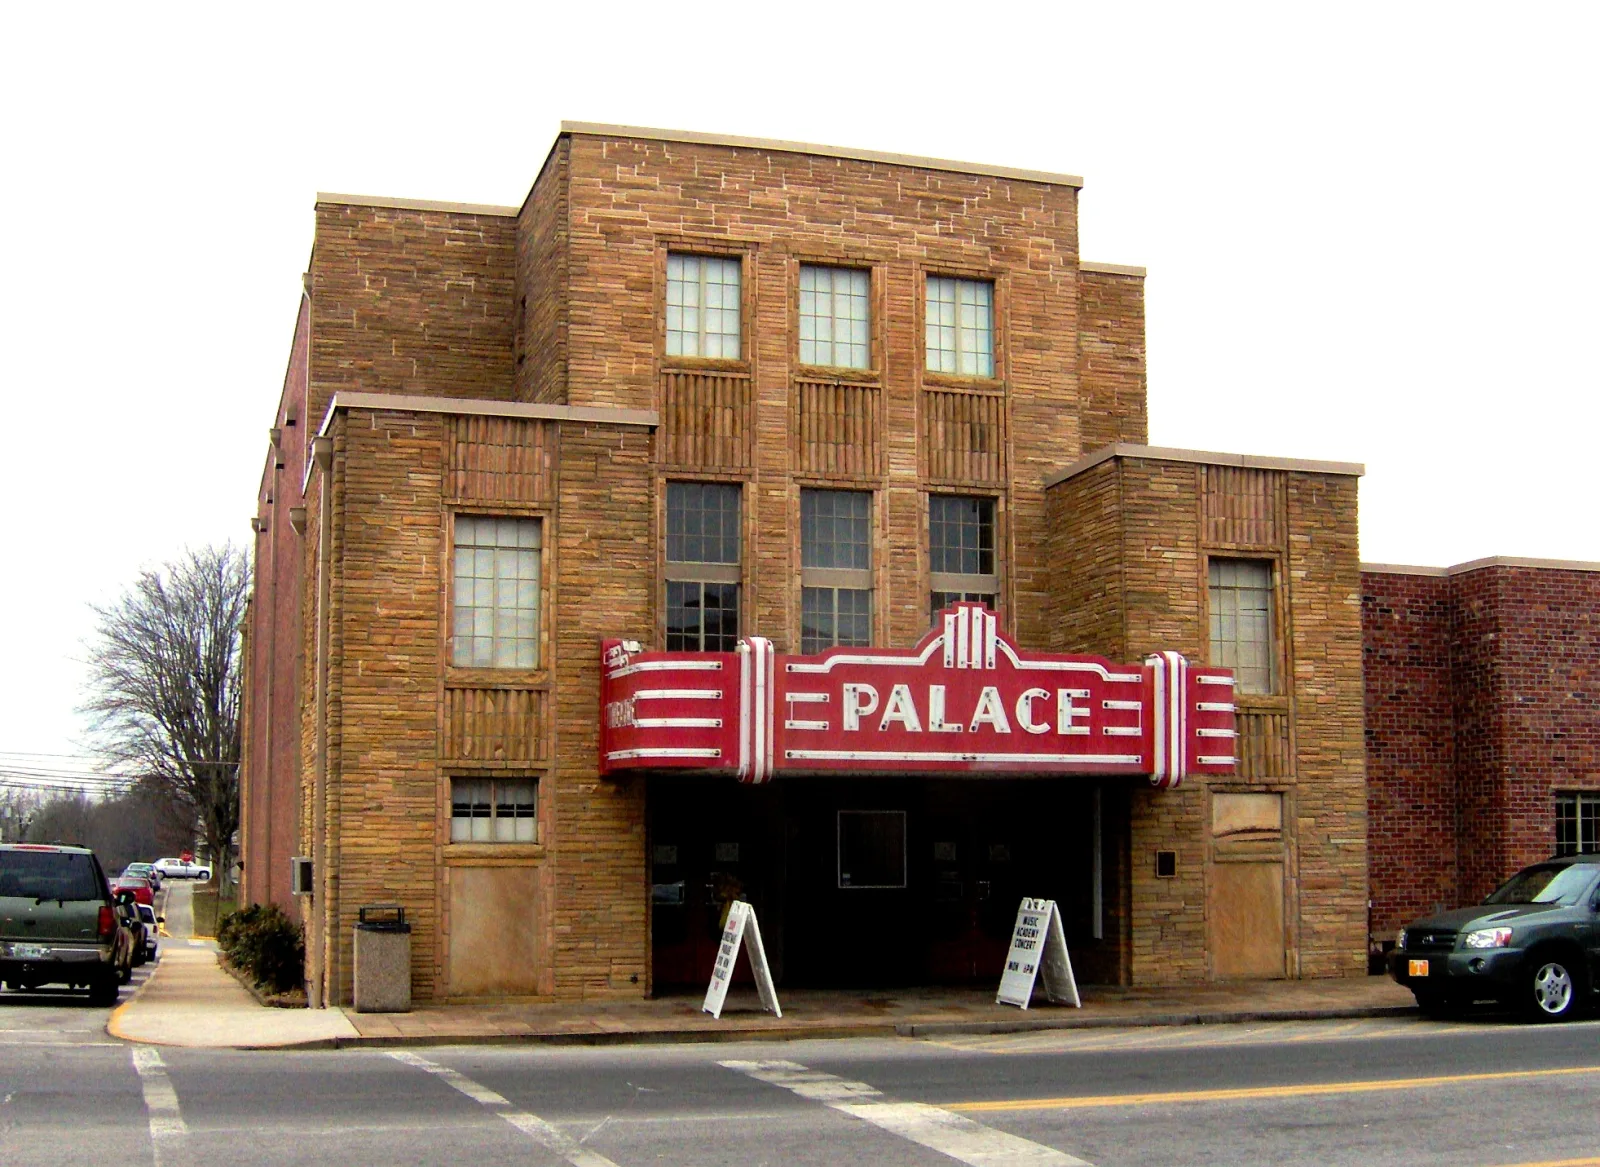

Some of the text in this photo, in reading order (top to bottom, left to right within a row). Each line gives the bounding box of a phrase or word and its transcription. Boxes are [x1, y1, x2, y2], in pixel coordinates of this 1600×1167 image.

[843, 683, 1090, 735] PALACE
[1023, 916, 1039, 927] MUSIC
[1016, 927, 1039, 938] ACADEMY
[1014, 938, 1036, 950] CONCERT
